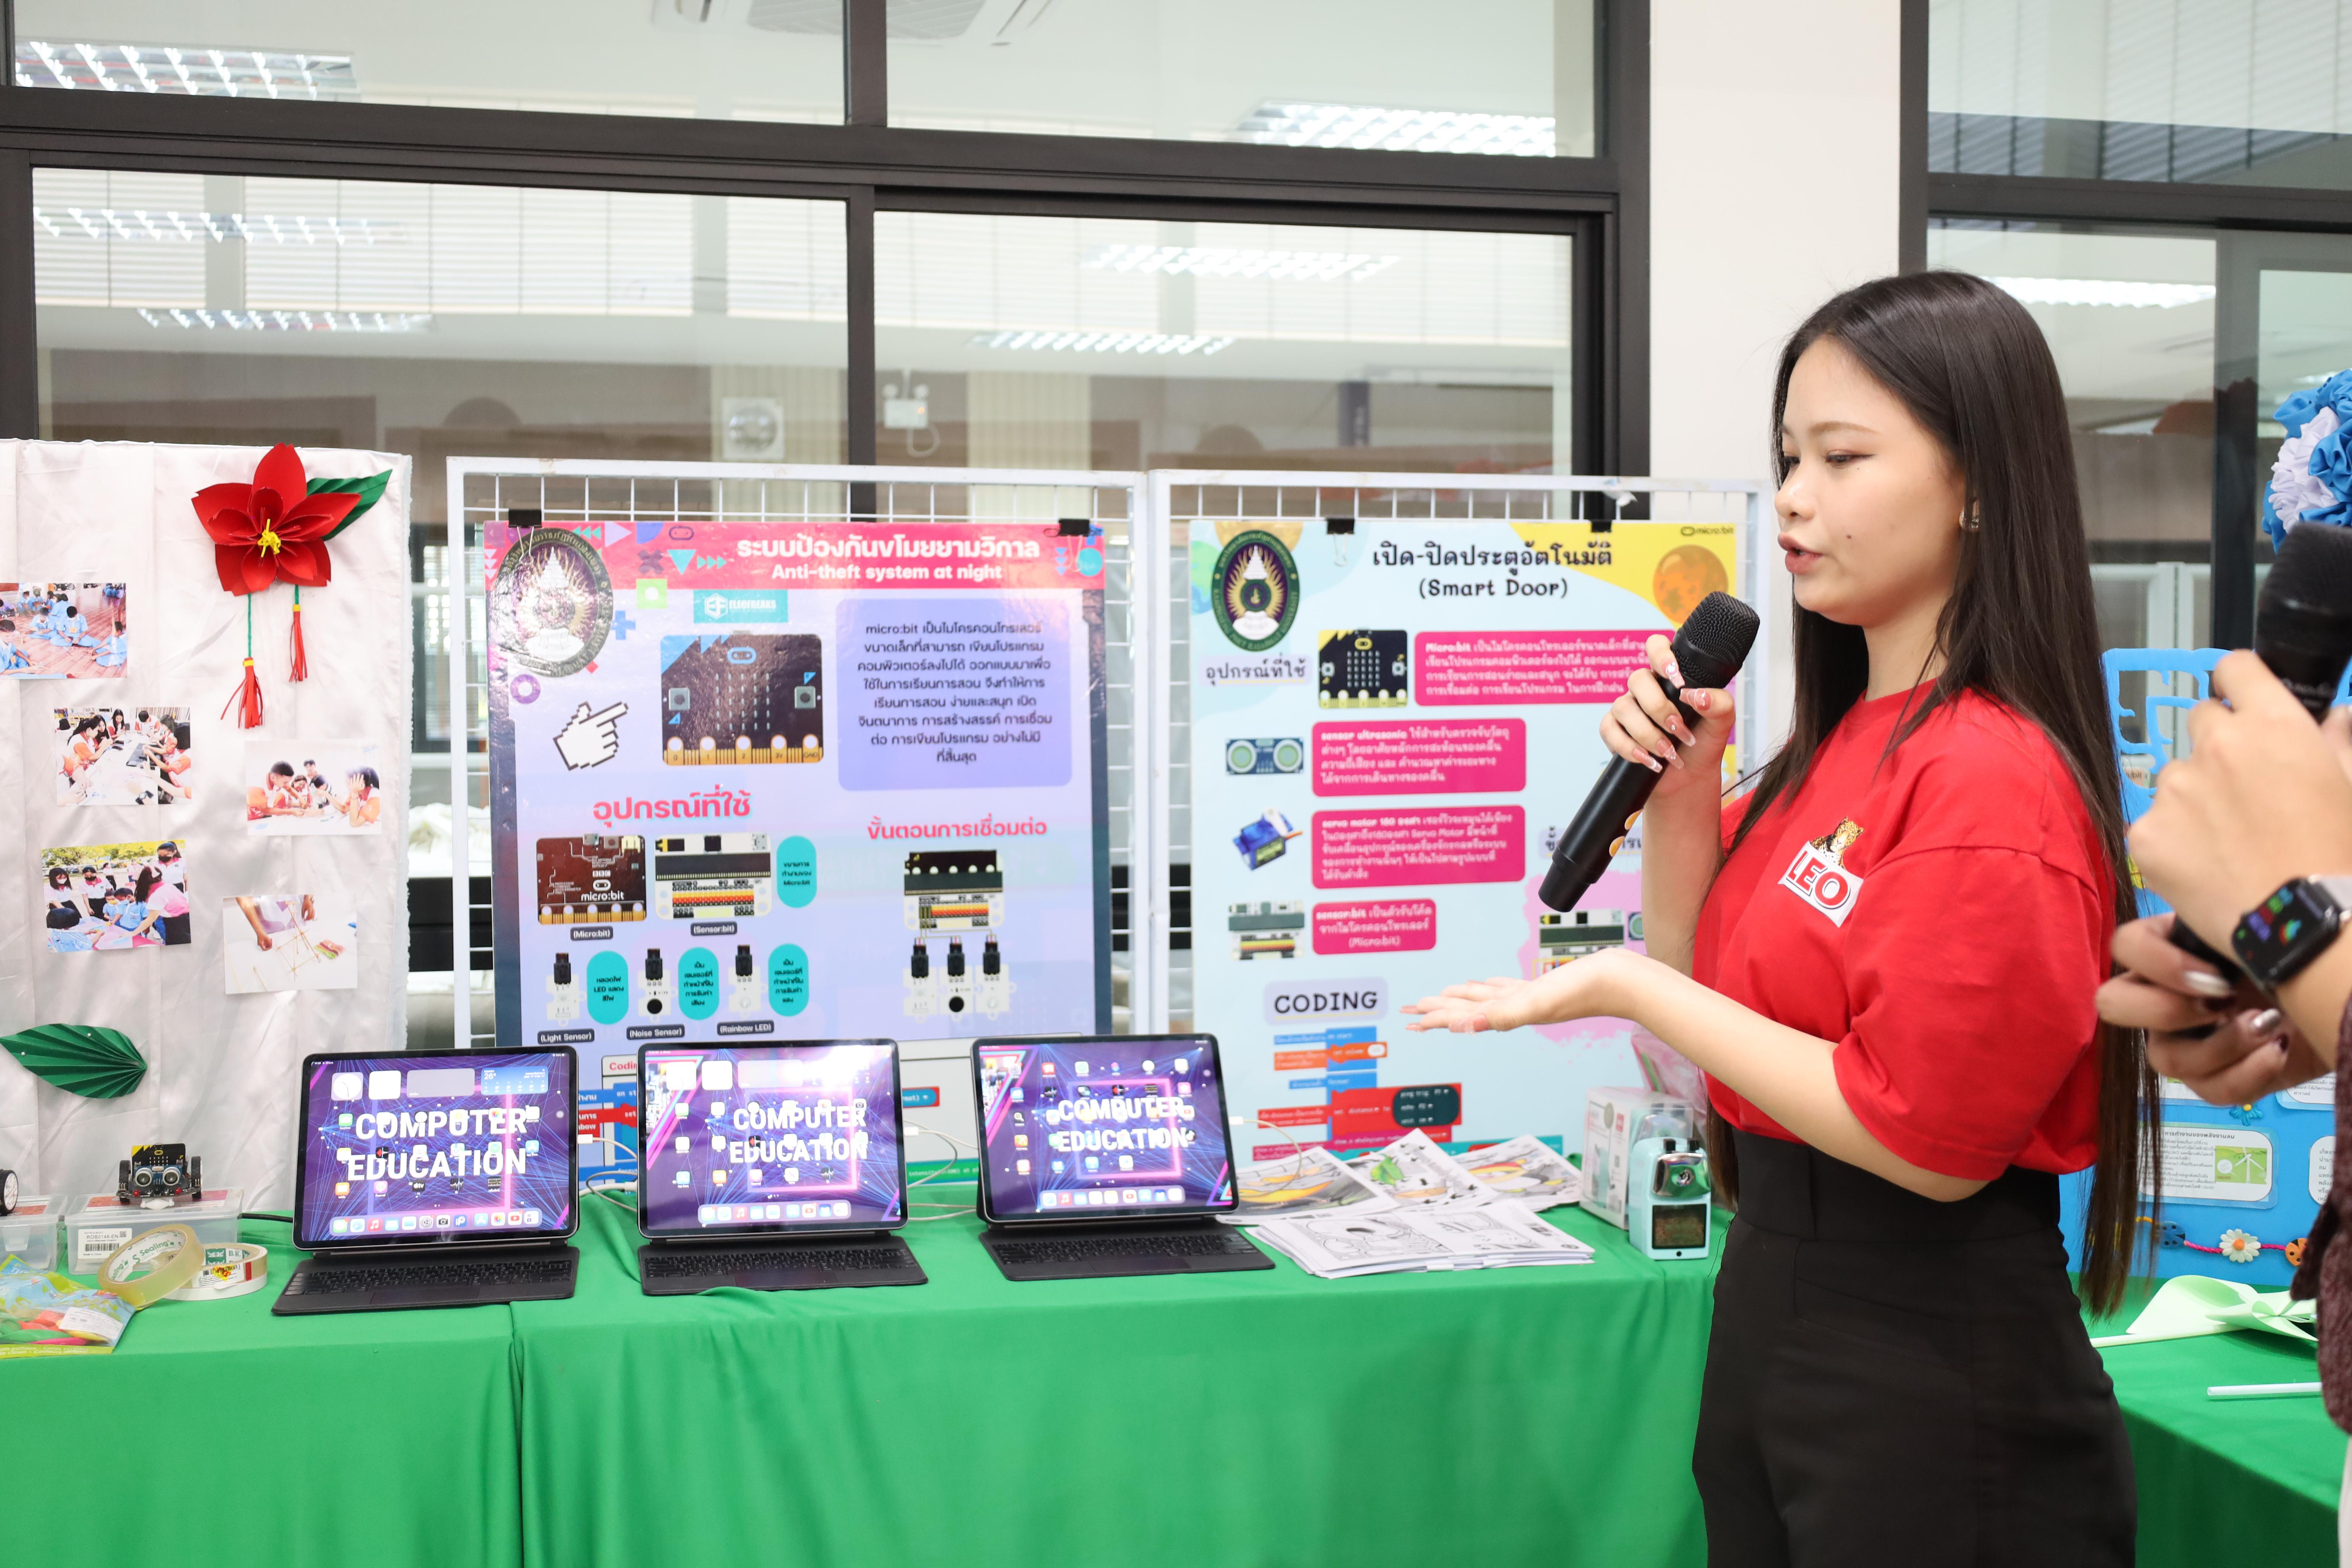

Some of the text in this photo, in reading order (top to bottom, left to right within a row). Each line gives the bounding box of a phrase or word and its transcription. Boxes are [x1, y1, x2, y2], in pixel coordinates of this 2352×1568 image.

[1695, 527, 1735, 535] micro:bit
[1373, 542, 1612, 574] เปิด-ปิดประตูอัตโนมัติ
[772, 564, 1002, 582] Anti-theft system at night
[1419, 579, 1569, 598] (Smart Door)
[866, 624, 918, 634] micro:bit
[1206, 653, 1306, 686] อุปกรณ์ที่ใช้
[1321, 732, 1355, 741] sensor
[1357, 729, 1408, 740] ultrasonic
[593, 784, 751, 828] อุปกรณ์ที่ใช้
[868, 813, 1047, 840] ขั้นตอนการเชื่อมต่อ
[1787, 850, 1851, 909] LEO
[581, 890, 625, 902] micro:bit
[573, 929, 611, 938] (Micro:bit)
[693, 925, 735, 934] (Sensor:bit)
[1274, 991, 1378, 1014] CODING
[540, 1032, 592, 1042] (Light Sensor)
[629, 1027, 682, 1038] (Noise Sensor)
[720, 1023, 772, 1034] (Rainbow LED)
[733, 1106, 867, 1130] COMPUTER
[1058, 1096, 1184, 1122] COMPUTER
[355, 1107, 527, 1140] COMPUTER
[729, 1138, 868, 1164] EDUCATION
[1058, 1127, 1188, 1152] EDUCATION
[348, 1148, 526, 1181] EDUCATION
